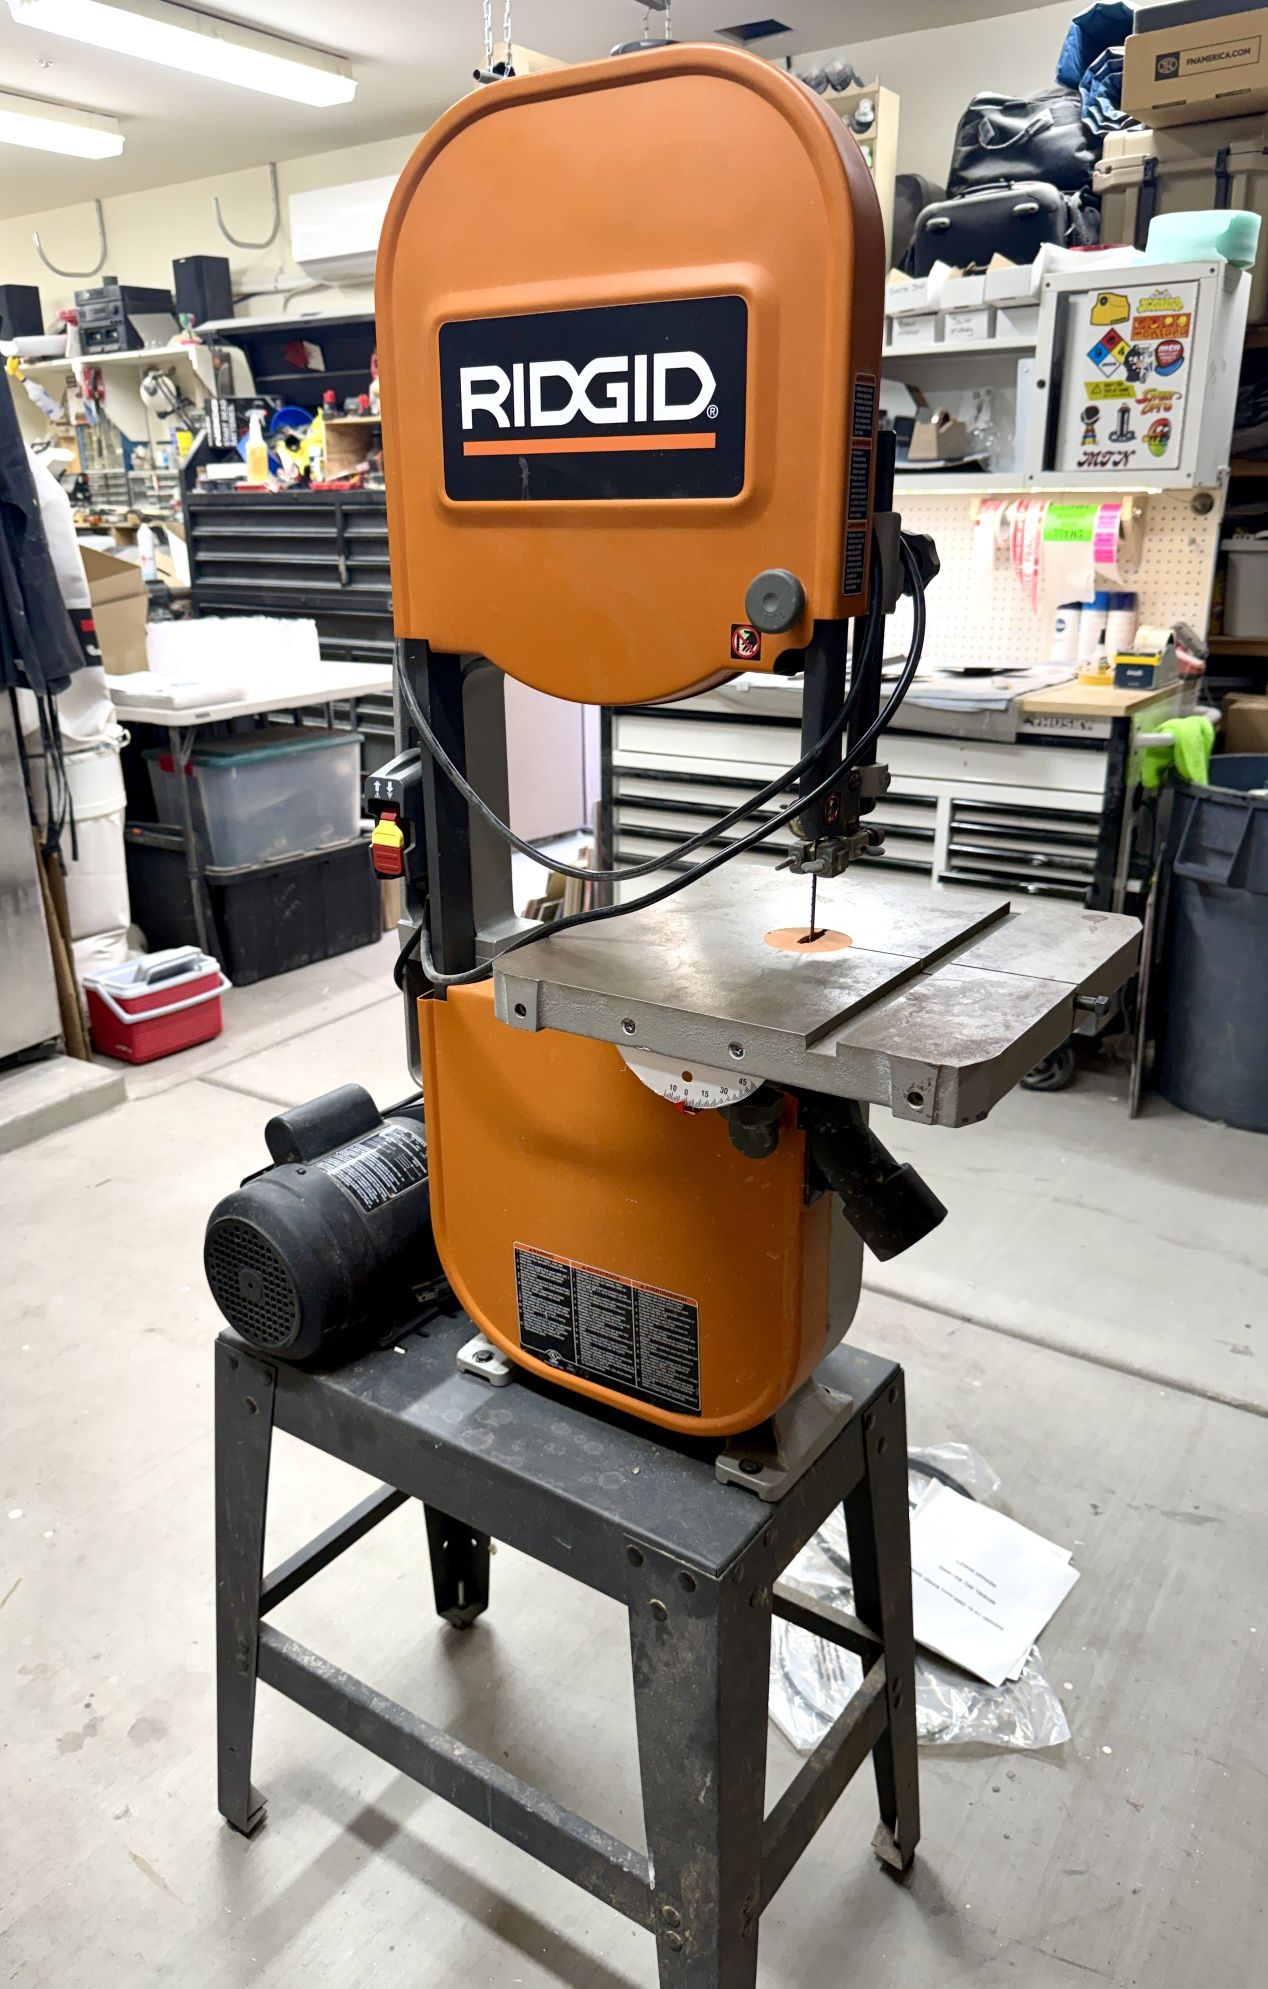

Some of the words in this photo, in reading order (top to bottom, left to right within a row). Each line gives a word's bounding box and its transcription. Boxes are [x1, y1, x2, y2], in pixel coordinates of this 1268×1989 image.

[1186, 47, 1252, 66] FNAMERICA.COM
[669, 1084, 677, 1092] 10
[701, 1090, 709, 1098] 15
[720, 1086, 728, 1095] 30
[738, 1078, 747, 1086] 45
